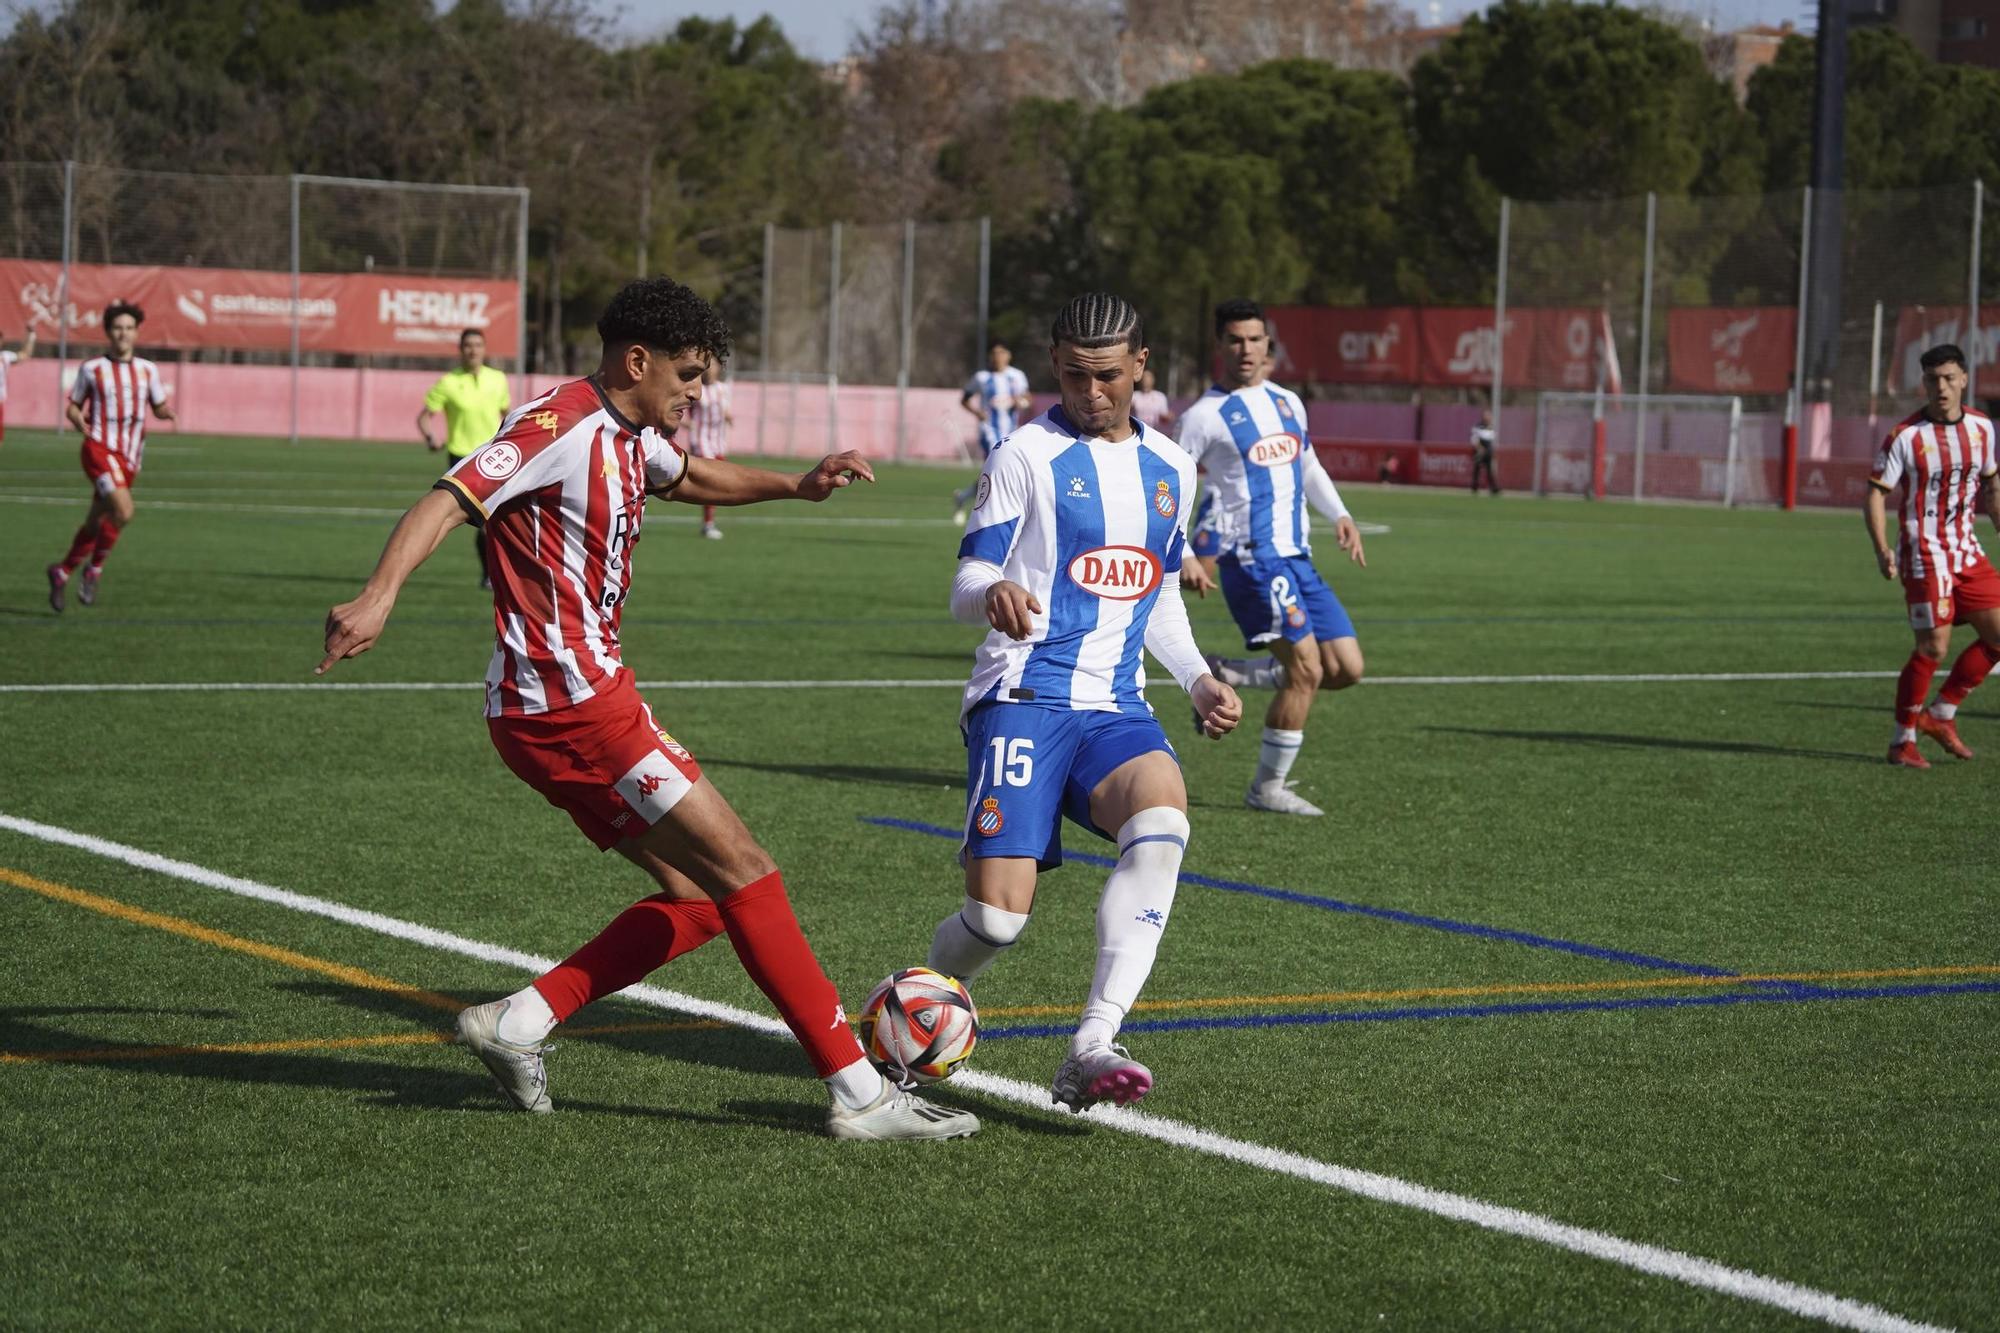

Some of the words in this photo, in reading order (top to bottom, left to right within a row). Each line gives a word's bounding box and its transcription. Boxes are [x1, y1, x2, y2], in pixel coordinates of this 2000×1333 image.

[379, 289, 490, 328] HERMZ
[1255, 440, 1293, 461] DANI
[1066, 490, 1091, 498] KELME
[1081, 557, 1148, 587] DANI
[1271, 575, 1297, 607] 2
[989, 736, 1035, 787] 15
